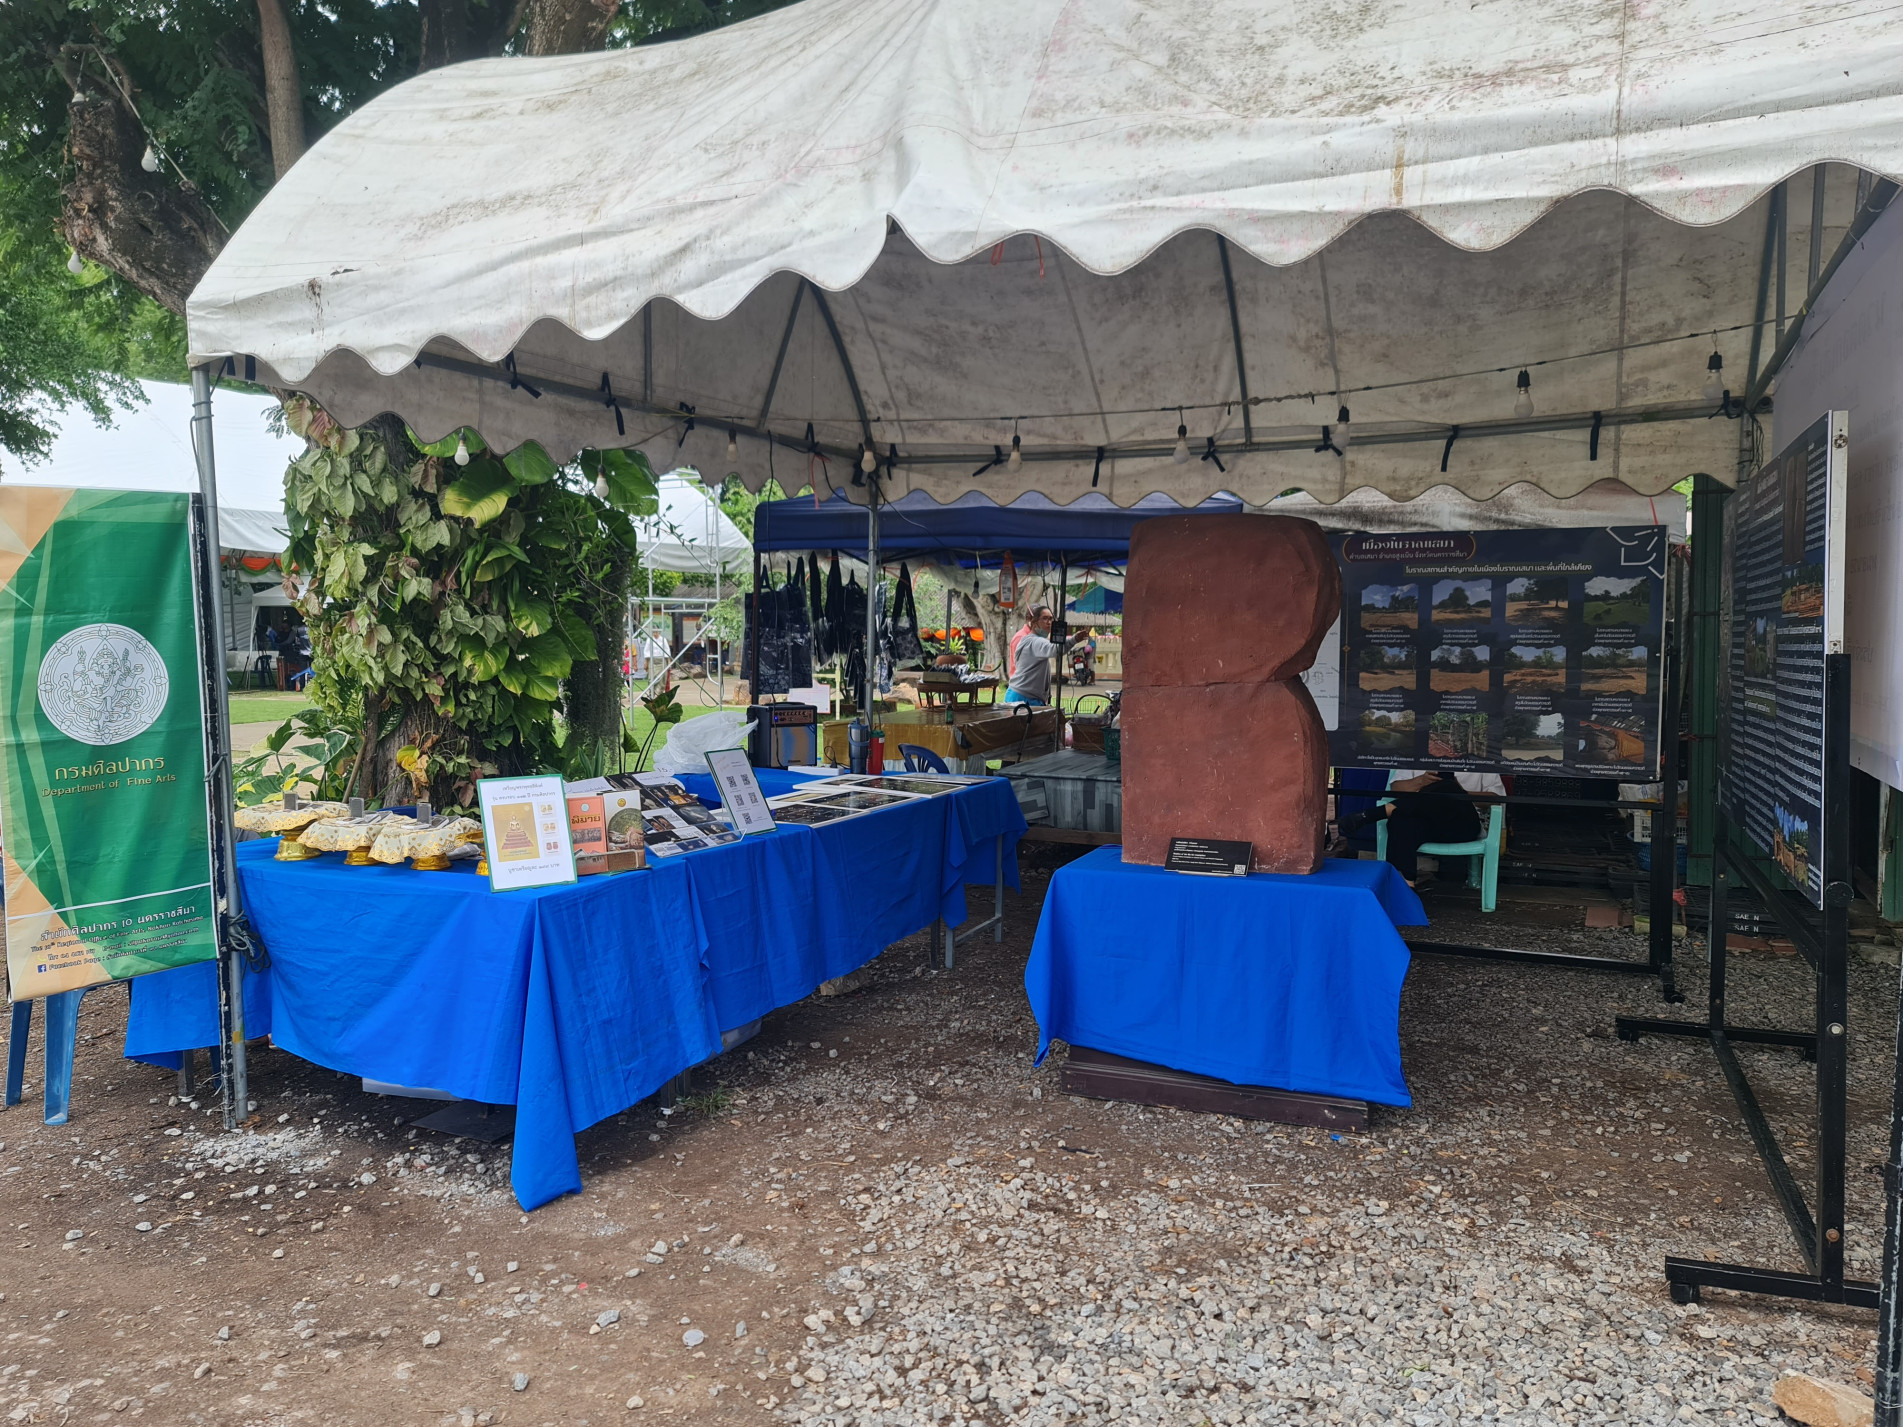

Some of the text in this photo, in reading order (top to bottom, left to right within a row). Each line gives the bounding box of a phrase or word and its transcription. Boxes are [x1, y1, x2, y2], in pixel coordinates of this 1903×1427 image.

[55, 757, 165, 781] กรมศิลปากร
[42, 774, 176, 797] Department of Fine Arts
[571, 815, 600, 825] พิมาย
[40, 921, 117, 942] สำนักศิลปากร
[137, 906, 195, 924] นครราชสีมา
